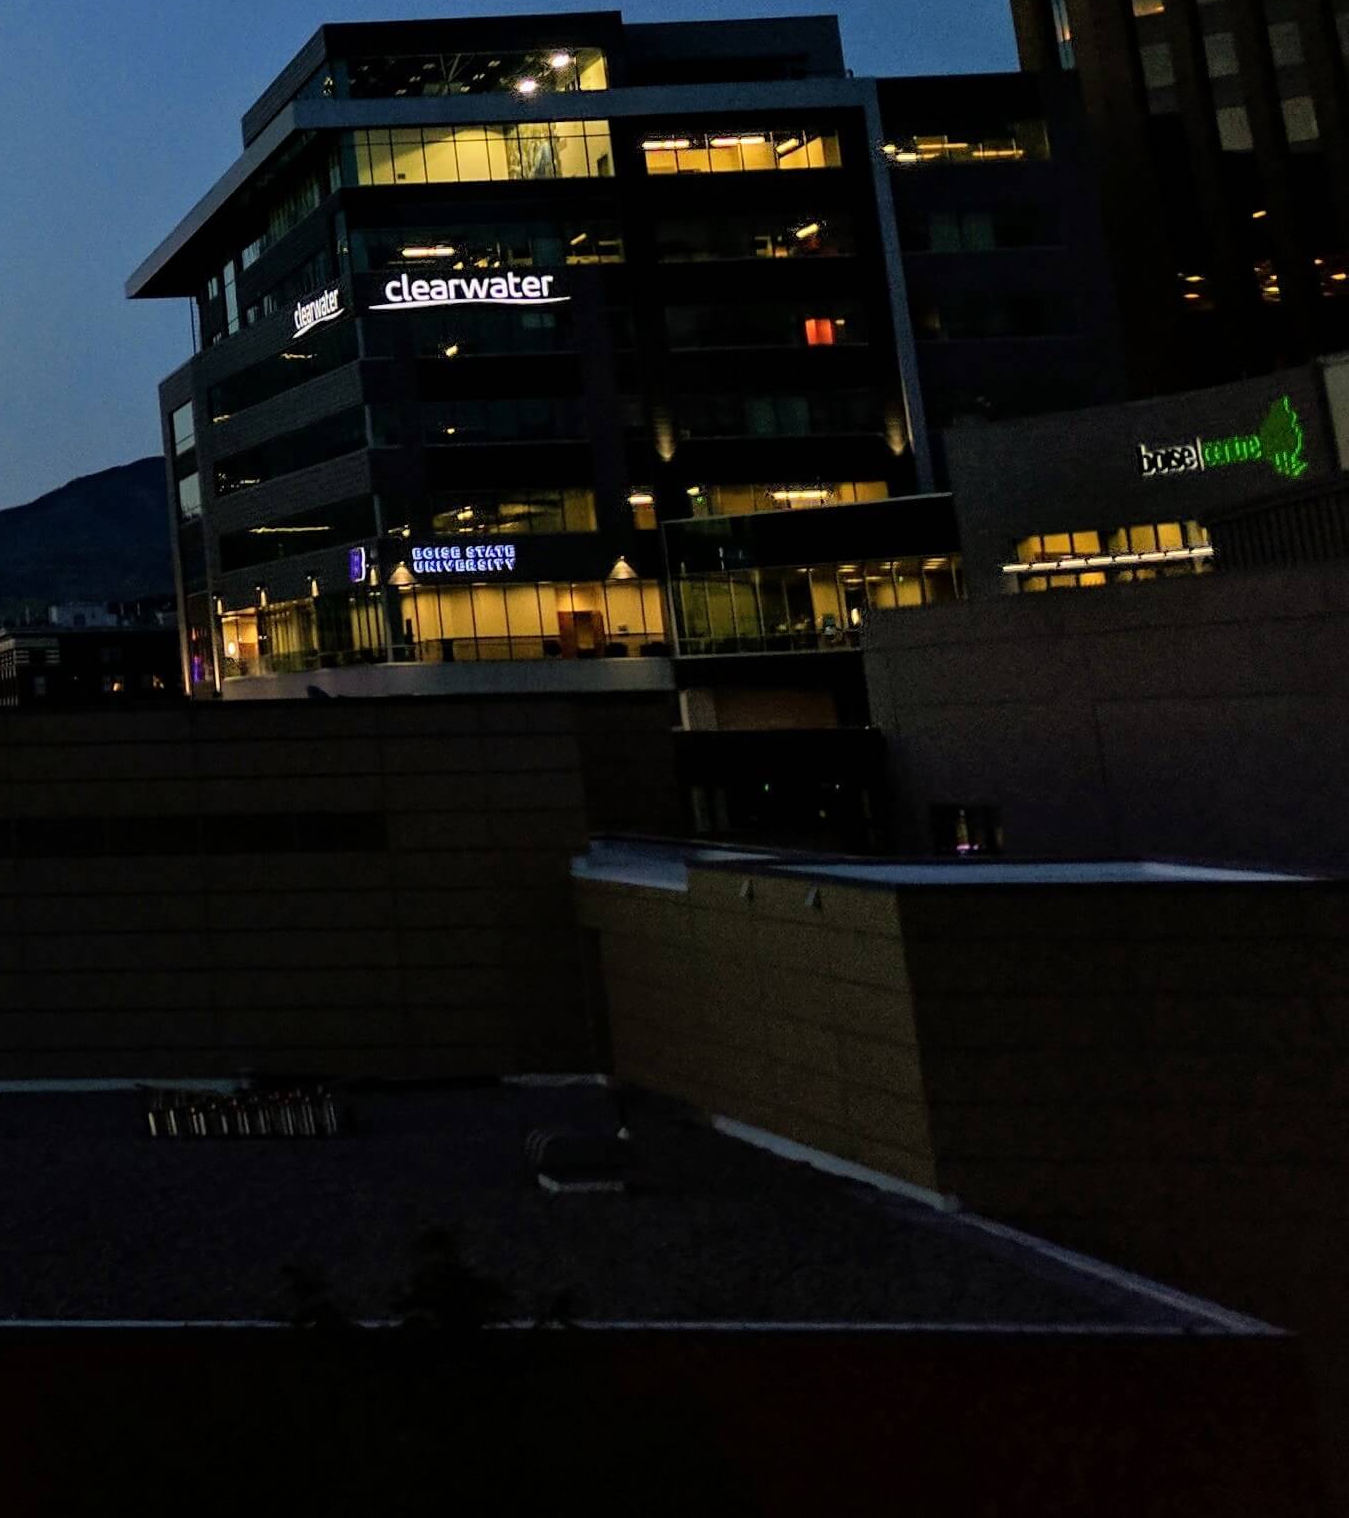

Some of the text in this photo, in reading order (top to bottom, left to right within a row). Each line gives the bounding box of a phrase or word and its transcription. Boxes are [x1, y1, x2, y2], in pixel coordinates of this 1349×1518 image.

[384, 271, 554, 301] clearwater
[293, 288, 339, 330] clearwater
[412, 545, 516, 560] BOISE STATE
[413, 559, 516, 573] UNIVERSITY
